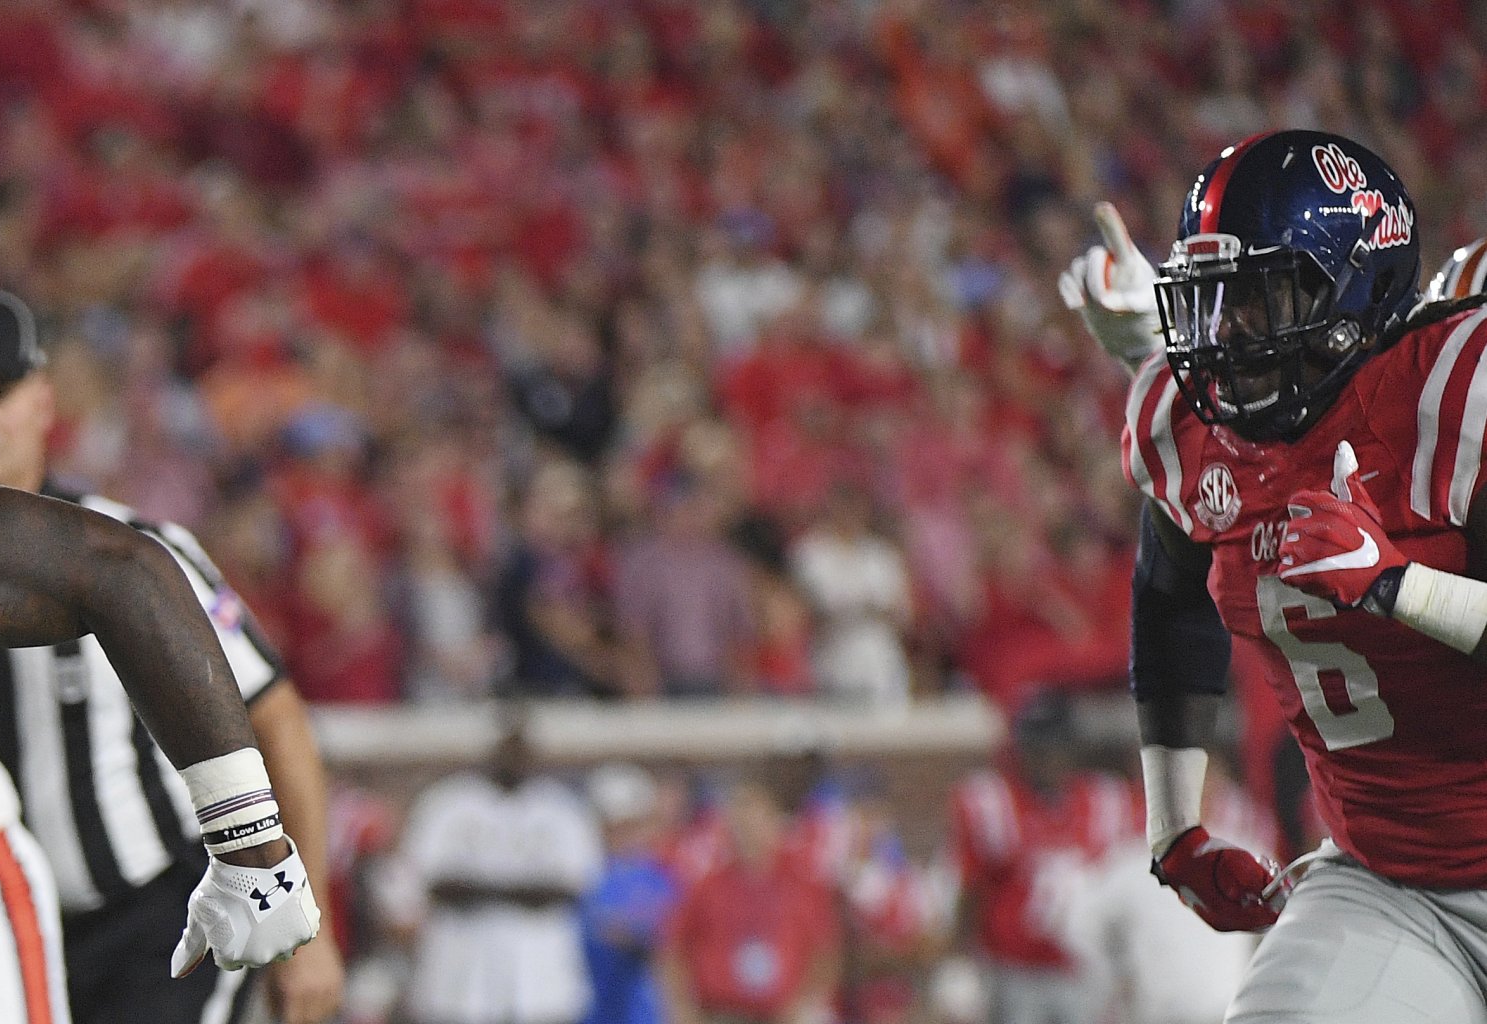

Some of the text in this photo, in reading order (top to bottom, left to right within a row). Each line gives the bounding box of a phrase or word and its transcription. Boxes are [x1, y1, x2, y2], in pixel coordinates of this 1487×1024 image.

[1312, 143, 1367, 194] Ole
[1351, 189, 1414, 250] Miss
[1202, 467, 1233, 515] SEC
[1256, 575, 1395, 752] 6
[232, 826, 255, 838] Low
